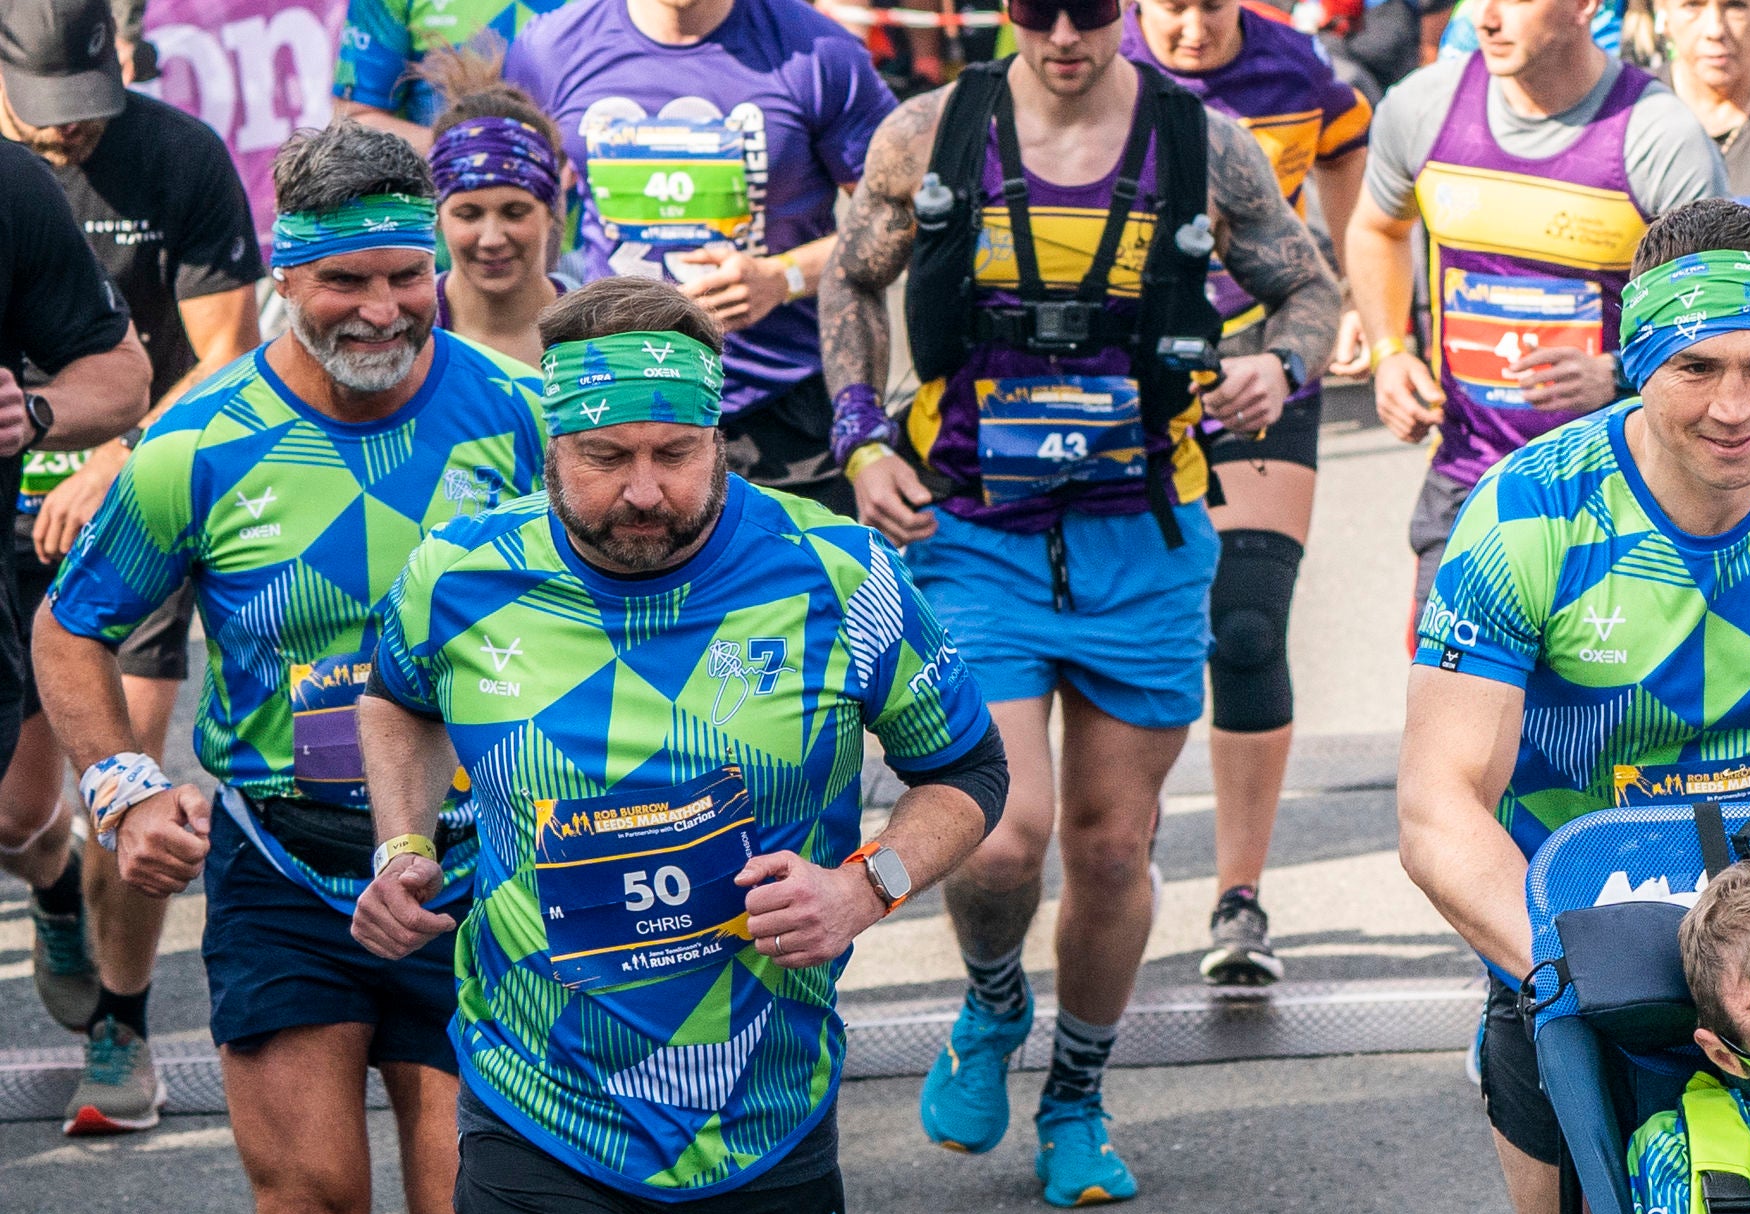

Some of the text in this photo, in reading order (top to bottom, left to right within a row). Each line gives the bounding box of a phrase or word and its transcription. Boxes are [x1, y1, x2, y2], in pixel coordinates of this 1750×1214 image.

[644, 171, 694, 202] 40
[1673, 310, 1707, 325] OXEN
[579, 374, 612, 385] ULTRA
[643, 367, 681, 378] OXEN
[1037, 432, 1089, 461] 43
[239, 523, 281, 540] OXEN
[1579, 648, 1627, 664] OXEN
[747, 637, 787, 696] 7
[479, 678, 521, 697] OXEN
[1687, 781, 1724, 794] LEEDS
[593, 802, 670, 821] ROB BURROW
[595, 796, 713, 833] LEEDS MARATHON
[624, 828, 660, 839] Partnership
[673, 809, 717, 833] Clarion
[623, 865, 691, 912] 50
[549, 905, 565, 920] M
[635, 914, 693, 935] CHRIS
[650, 942, 723, 968] RUN FOR ALL
